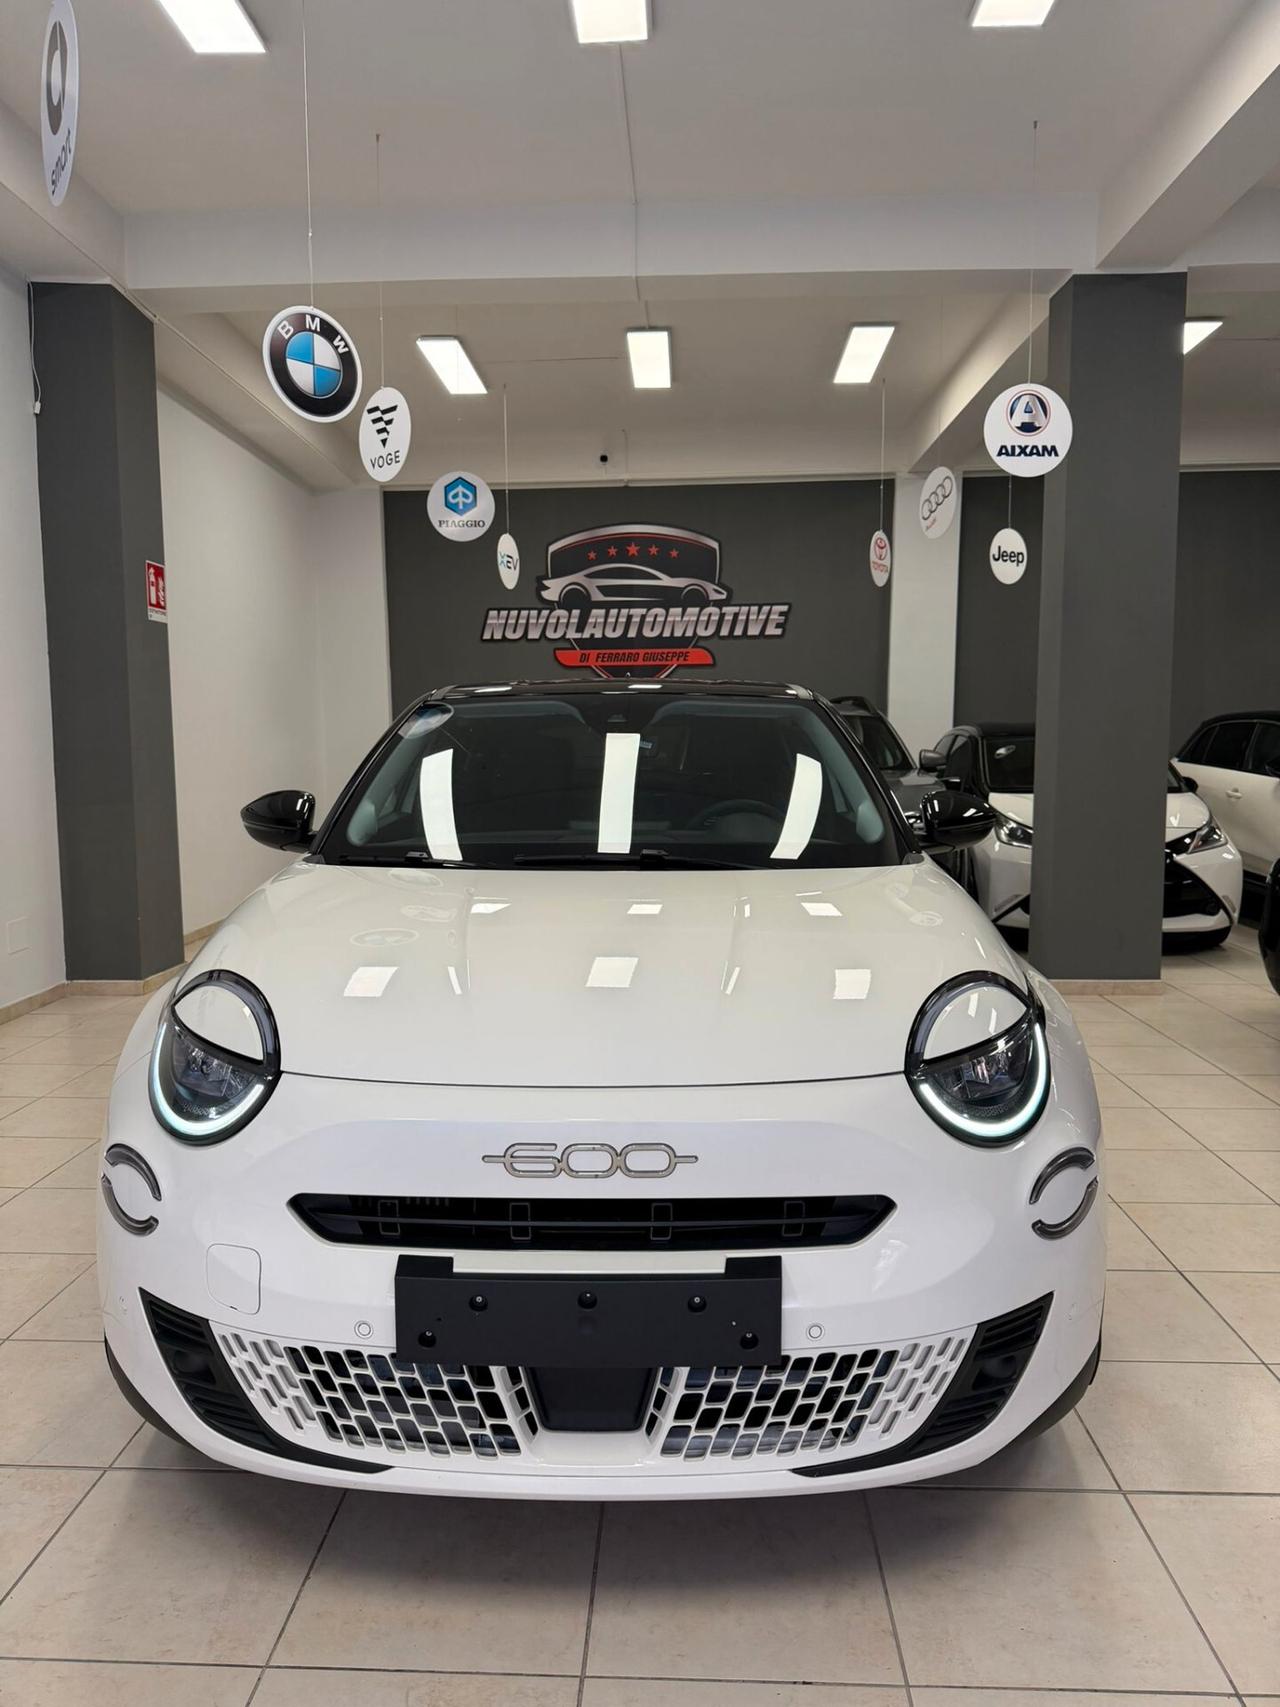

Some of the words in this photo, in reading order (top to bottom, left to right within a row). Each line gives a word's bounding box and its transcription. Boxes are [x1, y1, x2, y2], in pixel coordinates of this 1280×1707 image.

[277, 314, 349, 354] BMW
[370, 450, 400, 469] VOGE
[996, 445, 1059, 457] AIXAM
[438, 519, 485, 528] PIAGGIO
[992, 546, 1025, 567] Jeep
[482, 605, 789, 640] NUVOLAUTOMOTIVE
[579, 652, 590, 663] DI
[595, 652, 640, 663] FERRARO
[642, 651, 689, 662] GIUSEPPE
[503, 1142, 677, 1178] 600
